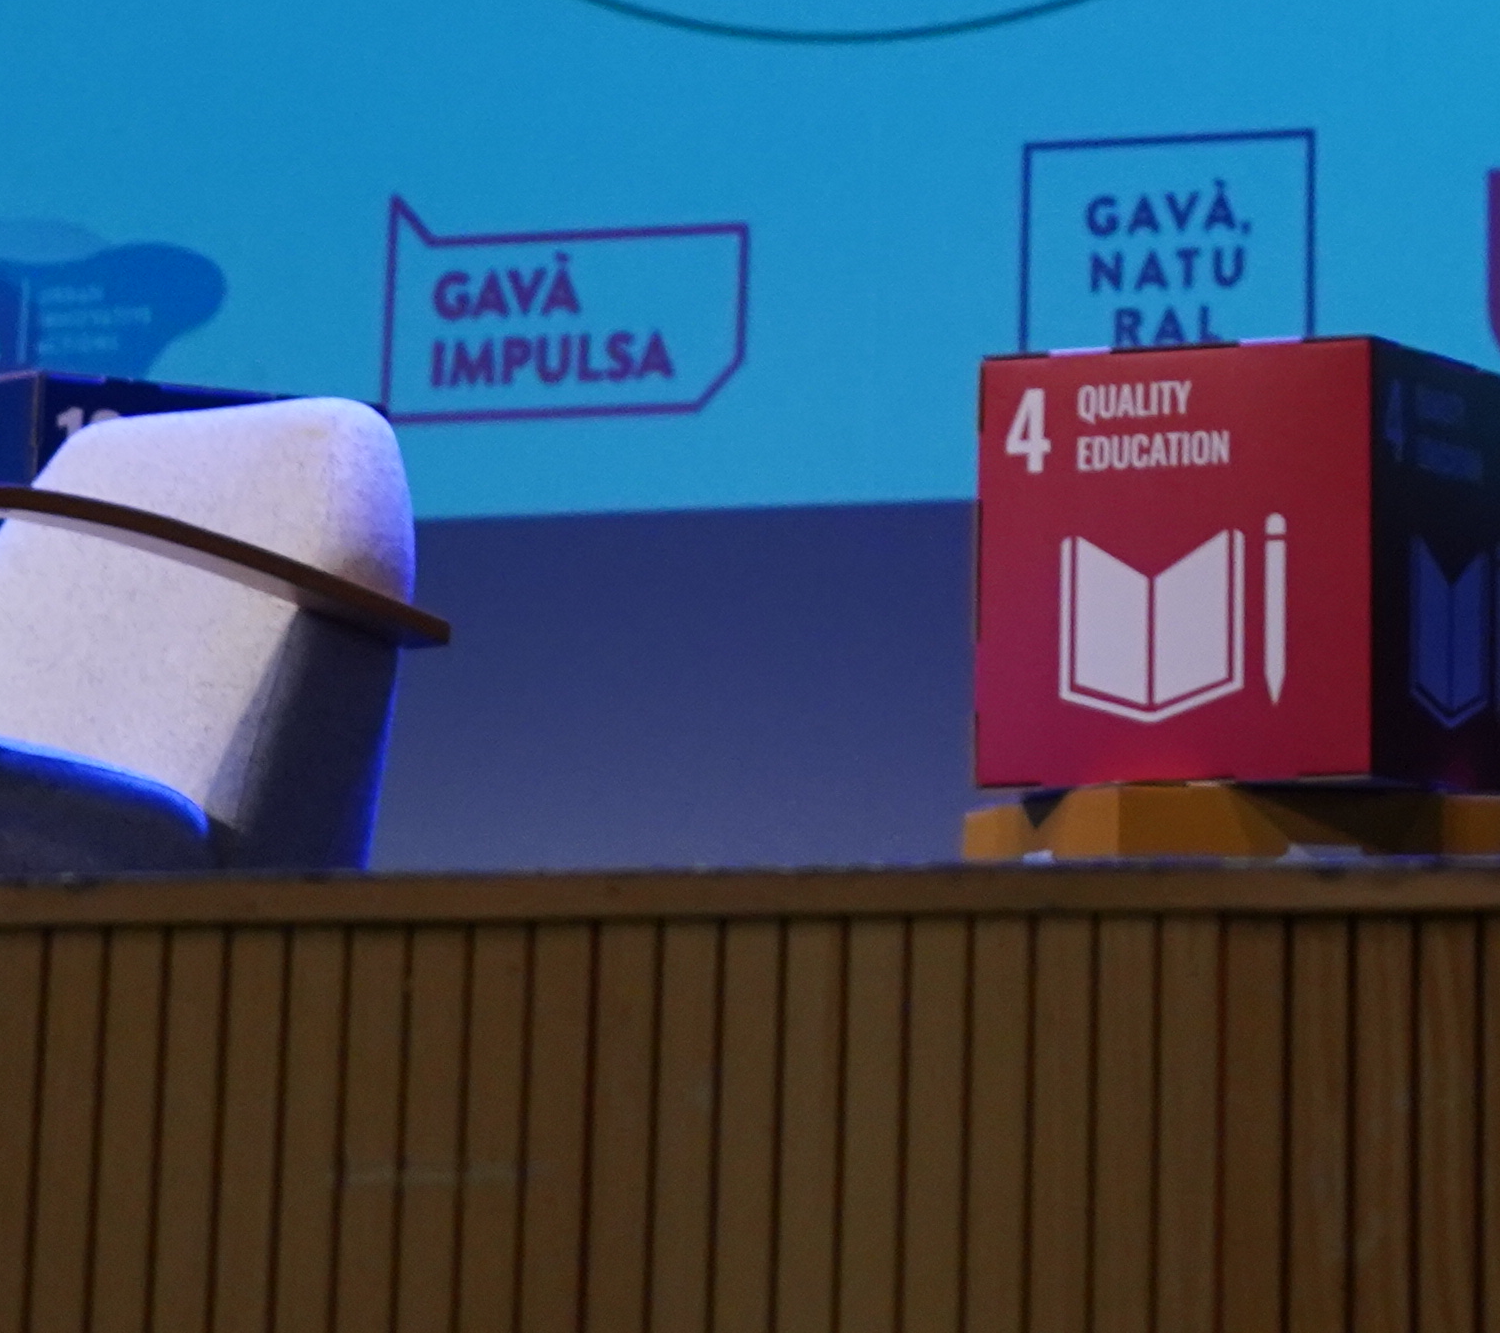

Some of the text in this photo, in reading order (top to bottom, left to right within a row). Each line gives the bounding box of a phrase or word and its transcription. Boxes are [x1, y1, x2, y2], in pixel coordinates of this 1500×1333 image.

[433, 251, 581, 321] GAVÀ
[1091, 245, 1247, 293] NATU
[1114, 306, 1221, 346] RAL
[431, 330, 674, 387] IMPULSA
[1006, 381, 1192, 472] 4 QUALITY
[1077, 430, 1230, 472] EDUCATION
